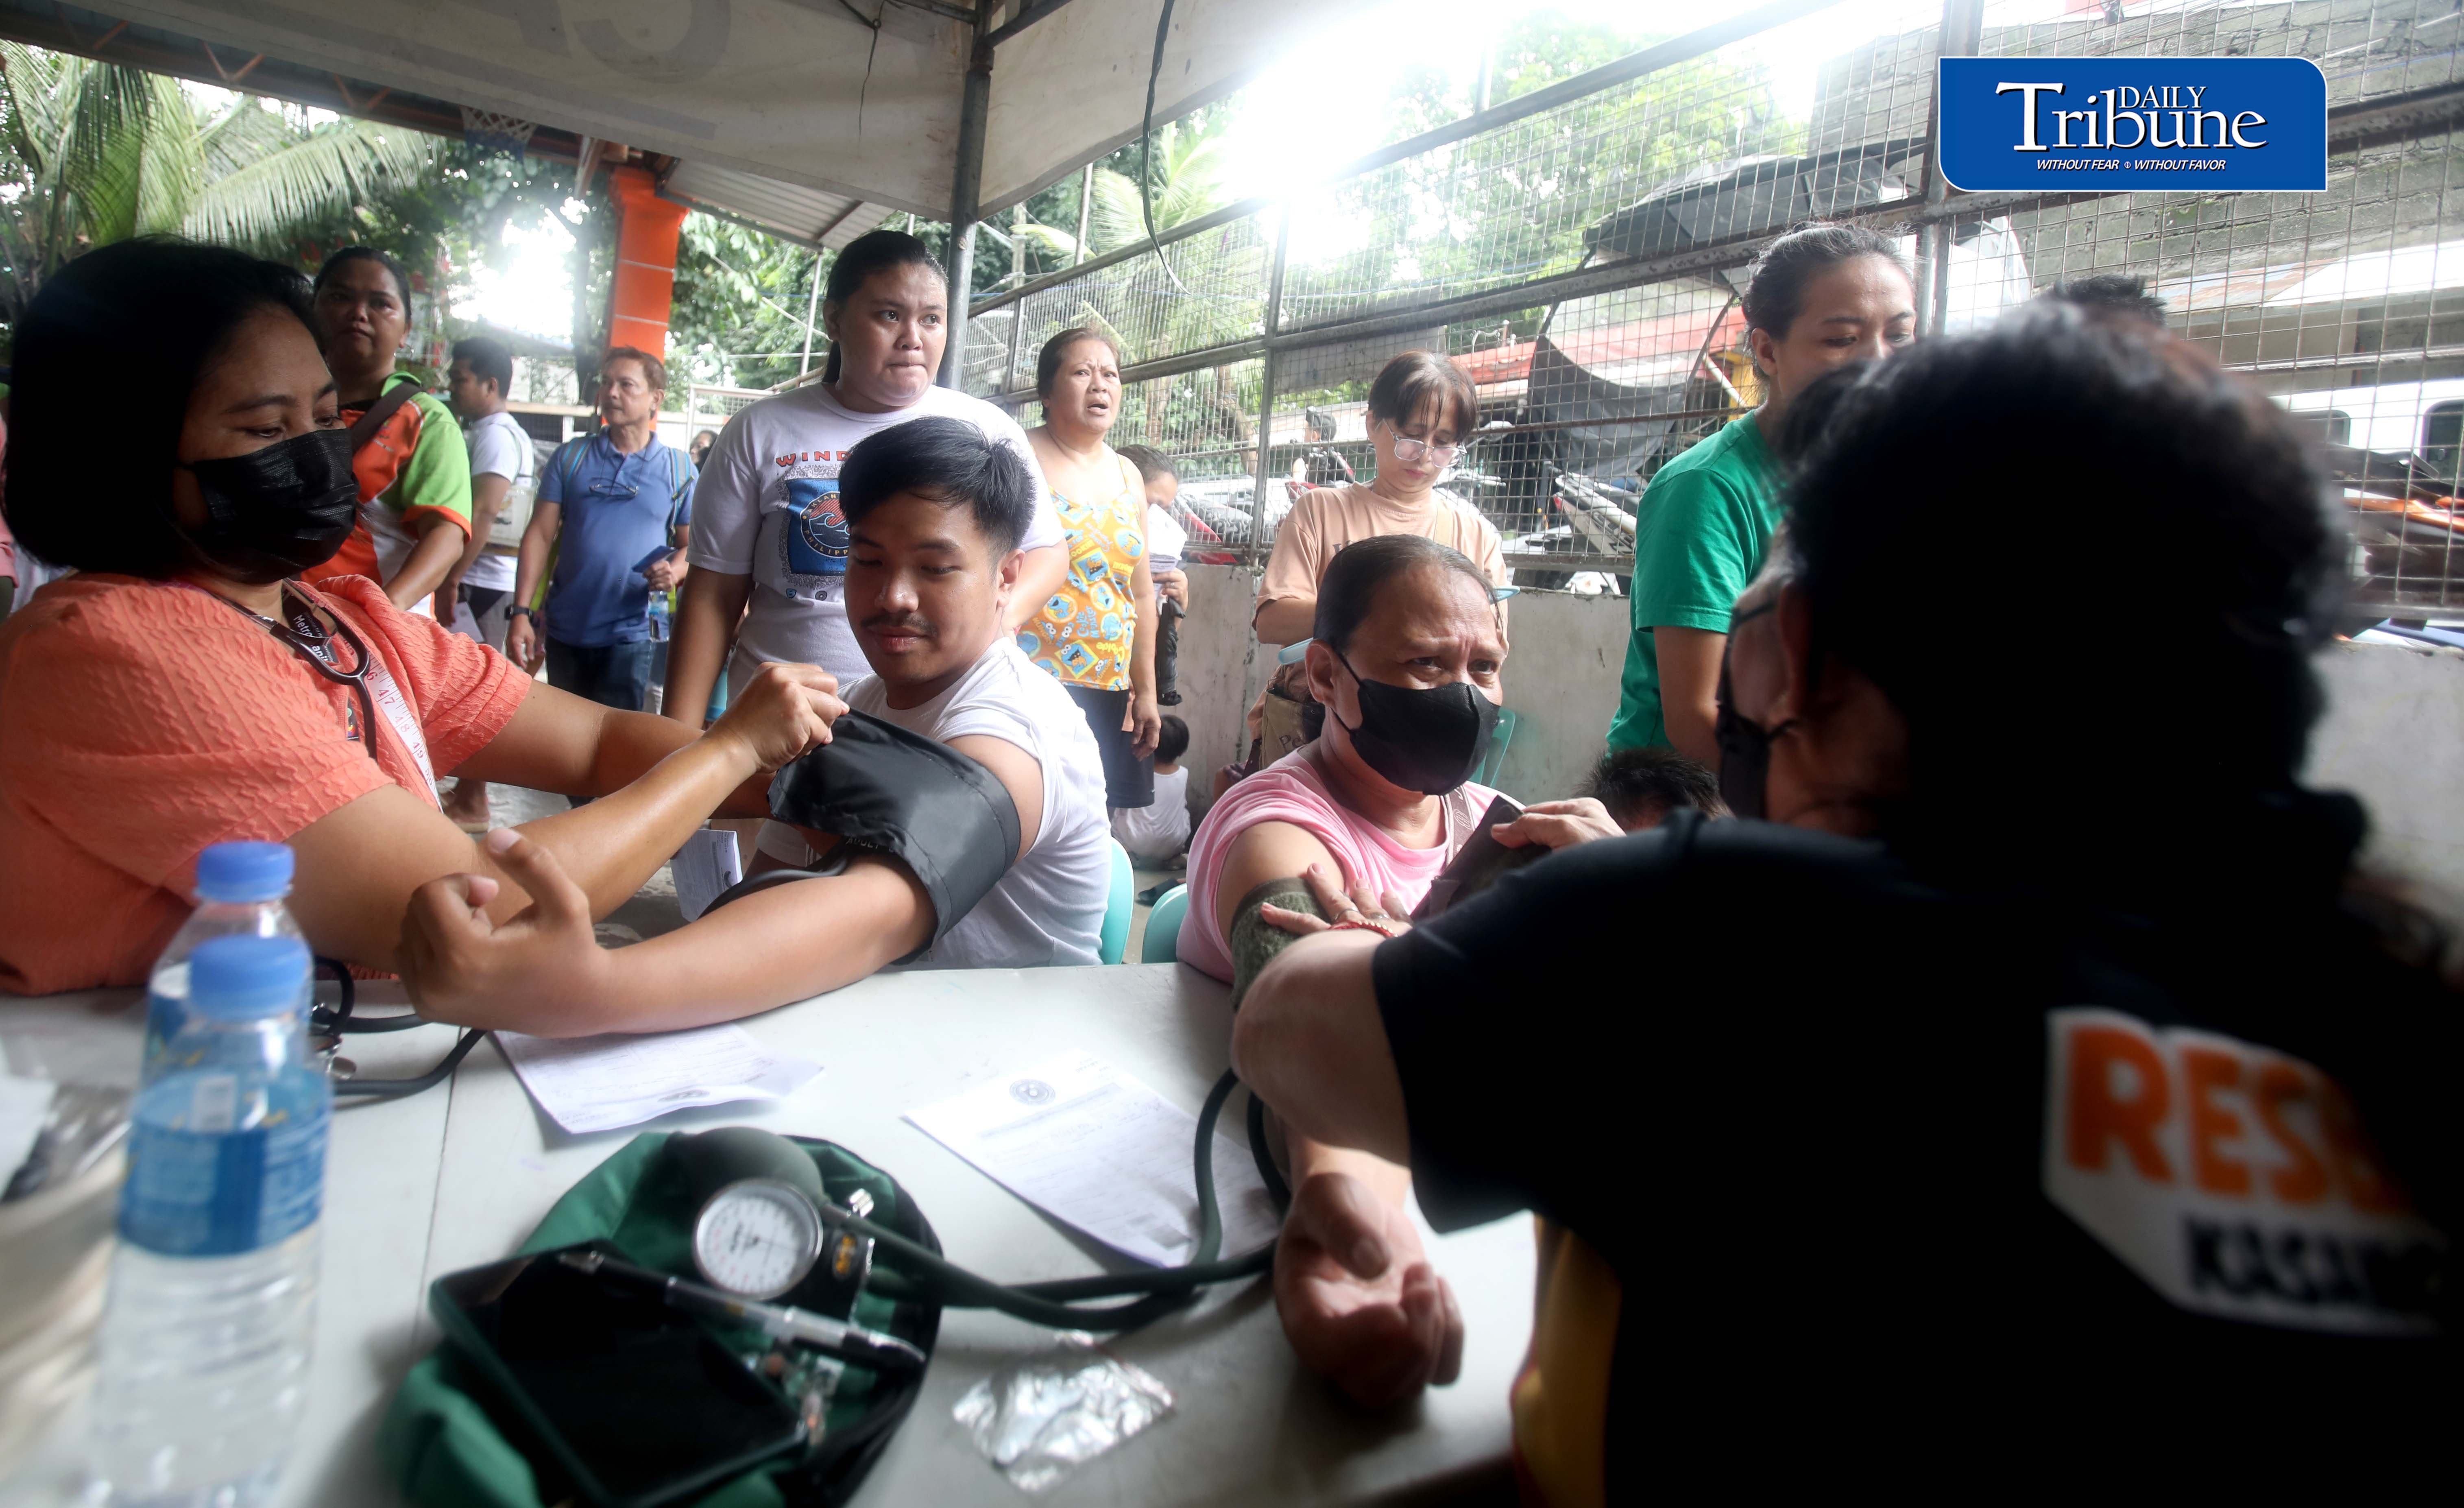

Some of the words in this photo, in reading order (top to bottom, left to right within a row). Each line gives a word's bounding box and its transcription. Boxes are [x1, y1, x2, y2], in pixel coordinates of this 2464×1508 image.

[776, 451, 852, 467] WIND
[807, 493, 837, 513] AKLAN
[804, 530, 848, 555] PHILIPP
[293, 614, 313, 637] Metro
